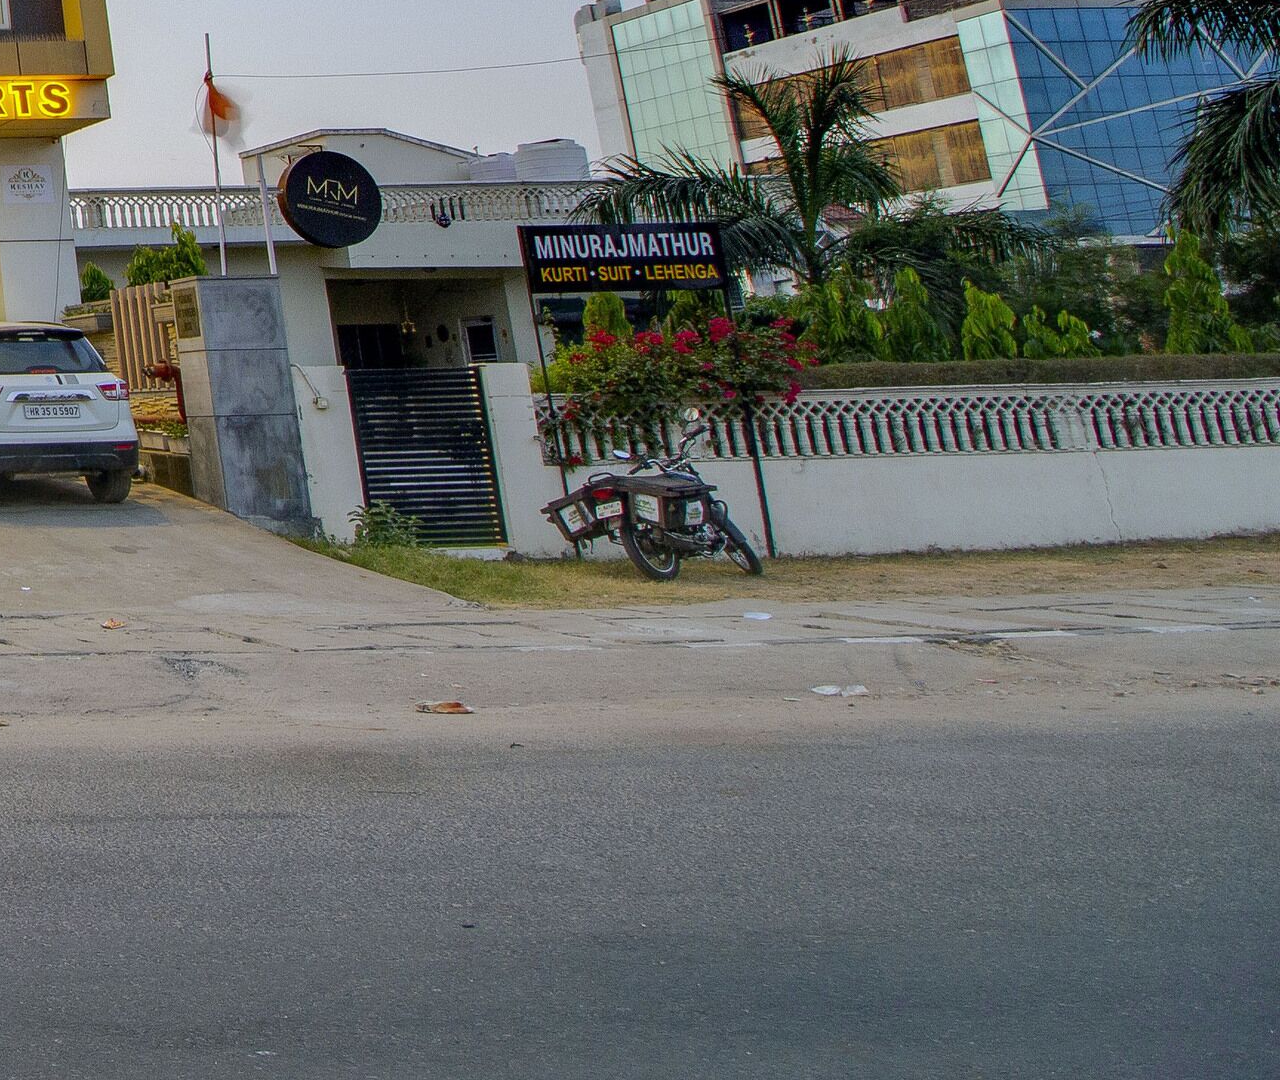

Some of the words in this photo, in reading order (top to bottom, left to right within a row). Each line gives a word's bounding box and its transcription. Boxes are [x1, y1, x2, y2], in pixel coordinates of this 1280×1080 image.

[10, 183, 45, 191] KESHAV
[533, 231, 715, 260] MINURAJMATHUR
[541, 266, 588, 282] KURTI
[598, 265, 632, 281] SUIT
[645, 264, 719, 280] LEHENGA
[30, 407, 40, 416] HR
[41, 407, 51, 416] 35
[59, 407, 78, 416] 5907
